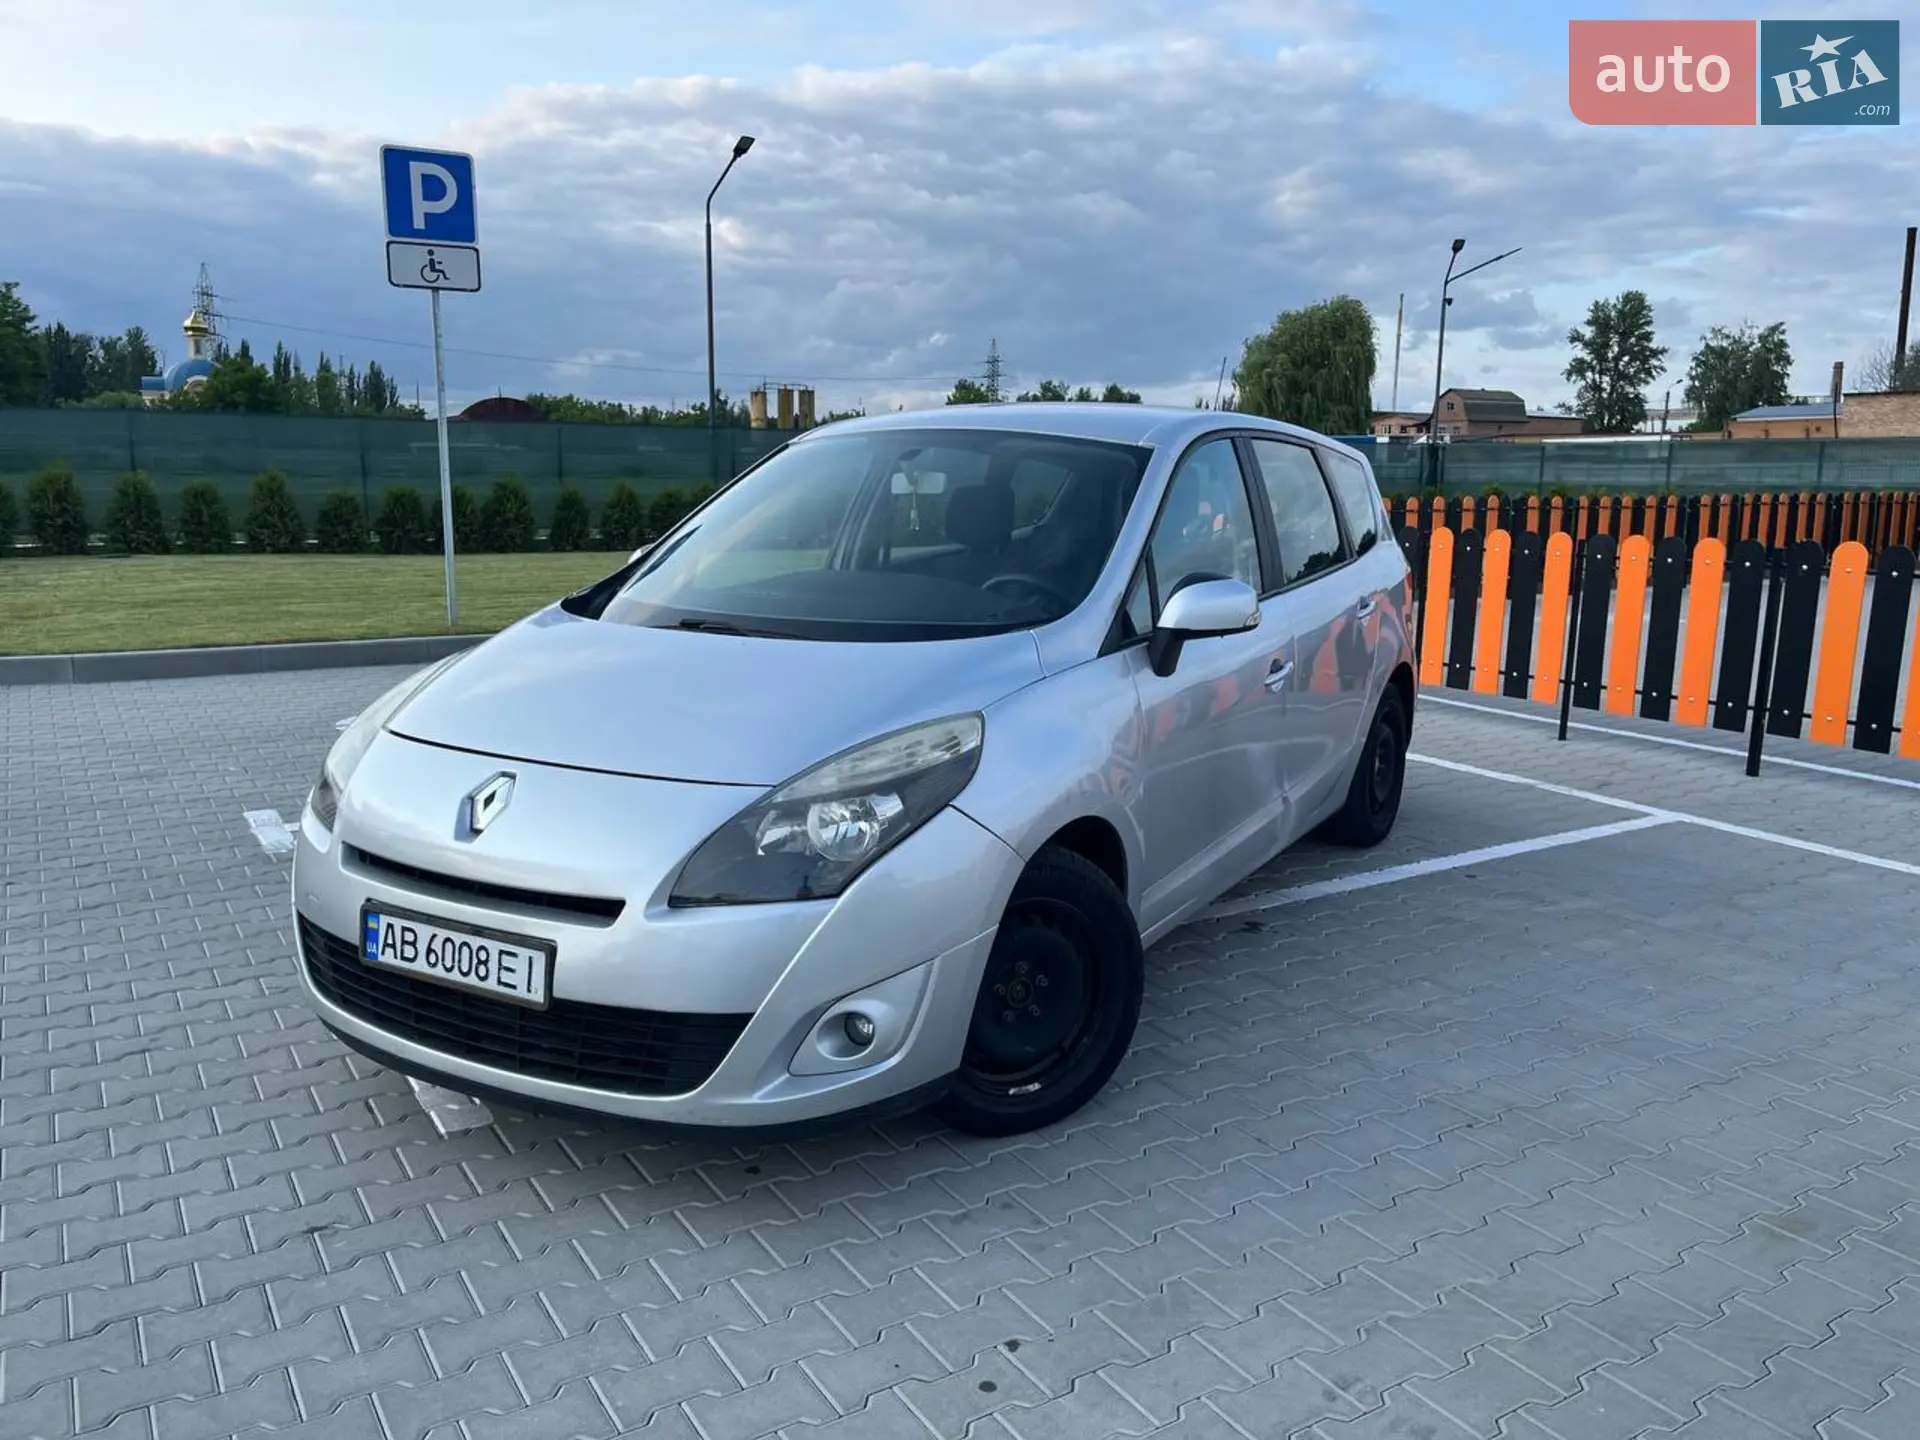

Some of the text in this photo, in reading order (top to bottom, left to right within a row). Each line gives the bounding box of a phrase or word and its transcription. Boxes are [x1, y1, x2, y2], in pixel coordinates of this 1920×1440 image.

[408, 160, 458, 230] P
[366, 940, 377, 954] UA
[381, 922, 534, 994] AB 6008 EI
